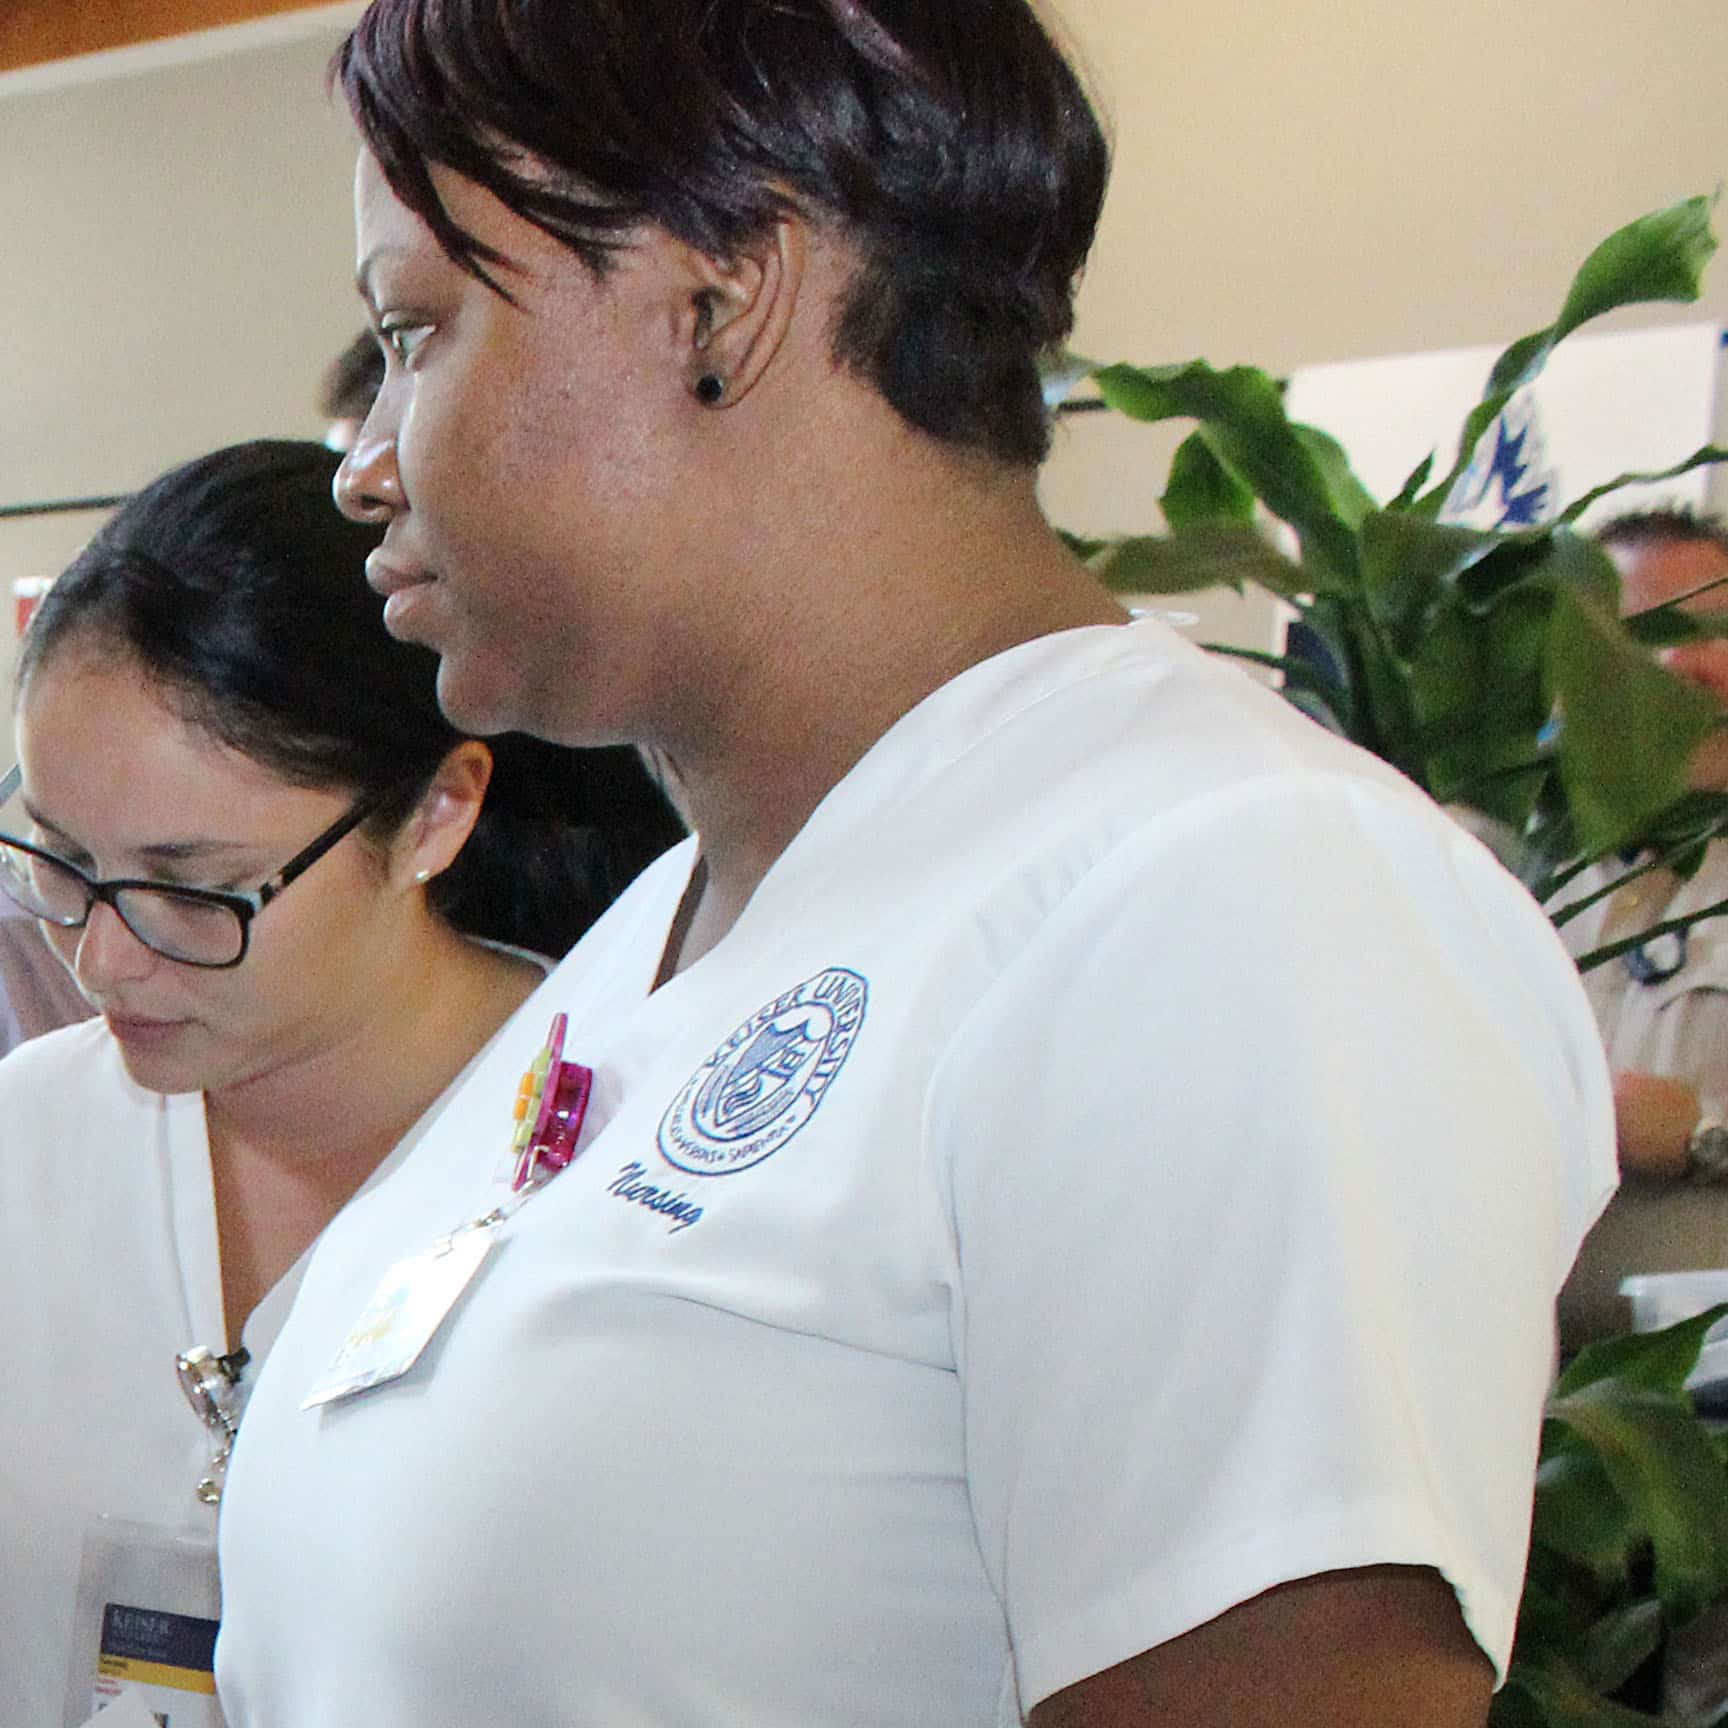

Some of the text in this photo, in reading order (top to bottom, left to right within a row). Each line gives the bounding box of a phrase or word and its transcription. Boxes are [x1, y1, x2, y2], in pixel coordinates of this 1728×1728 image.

[704, 975, 861, 1105] KEISER UNIVERSITY
[606, 1161, 705, 1234] Nursing
